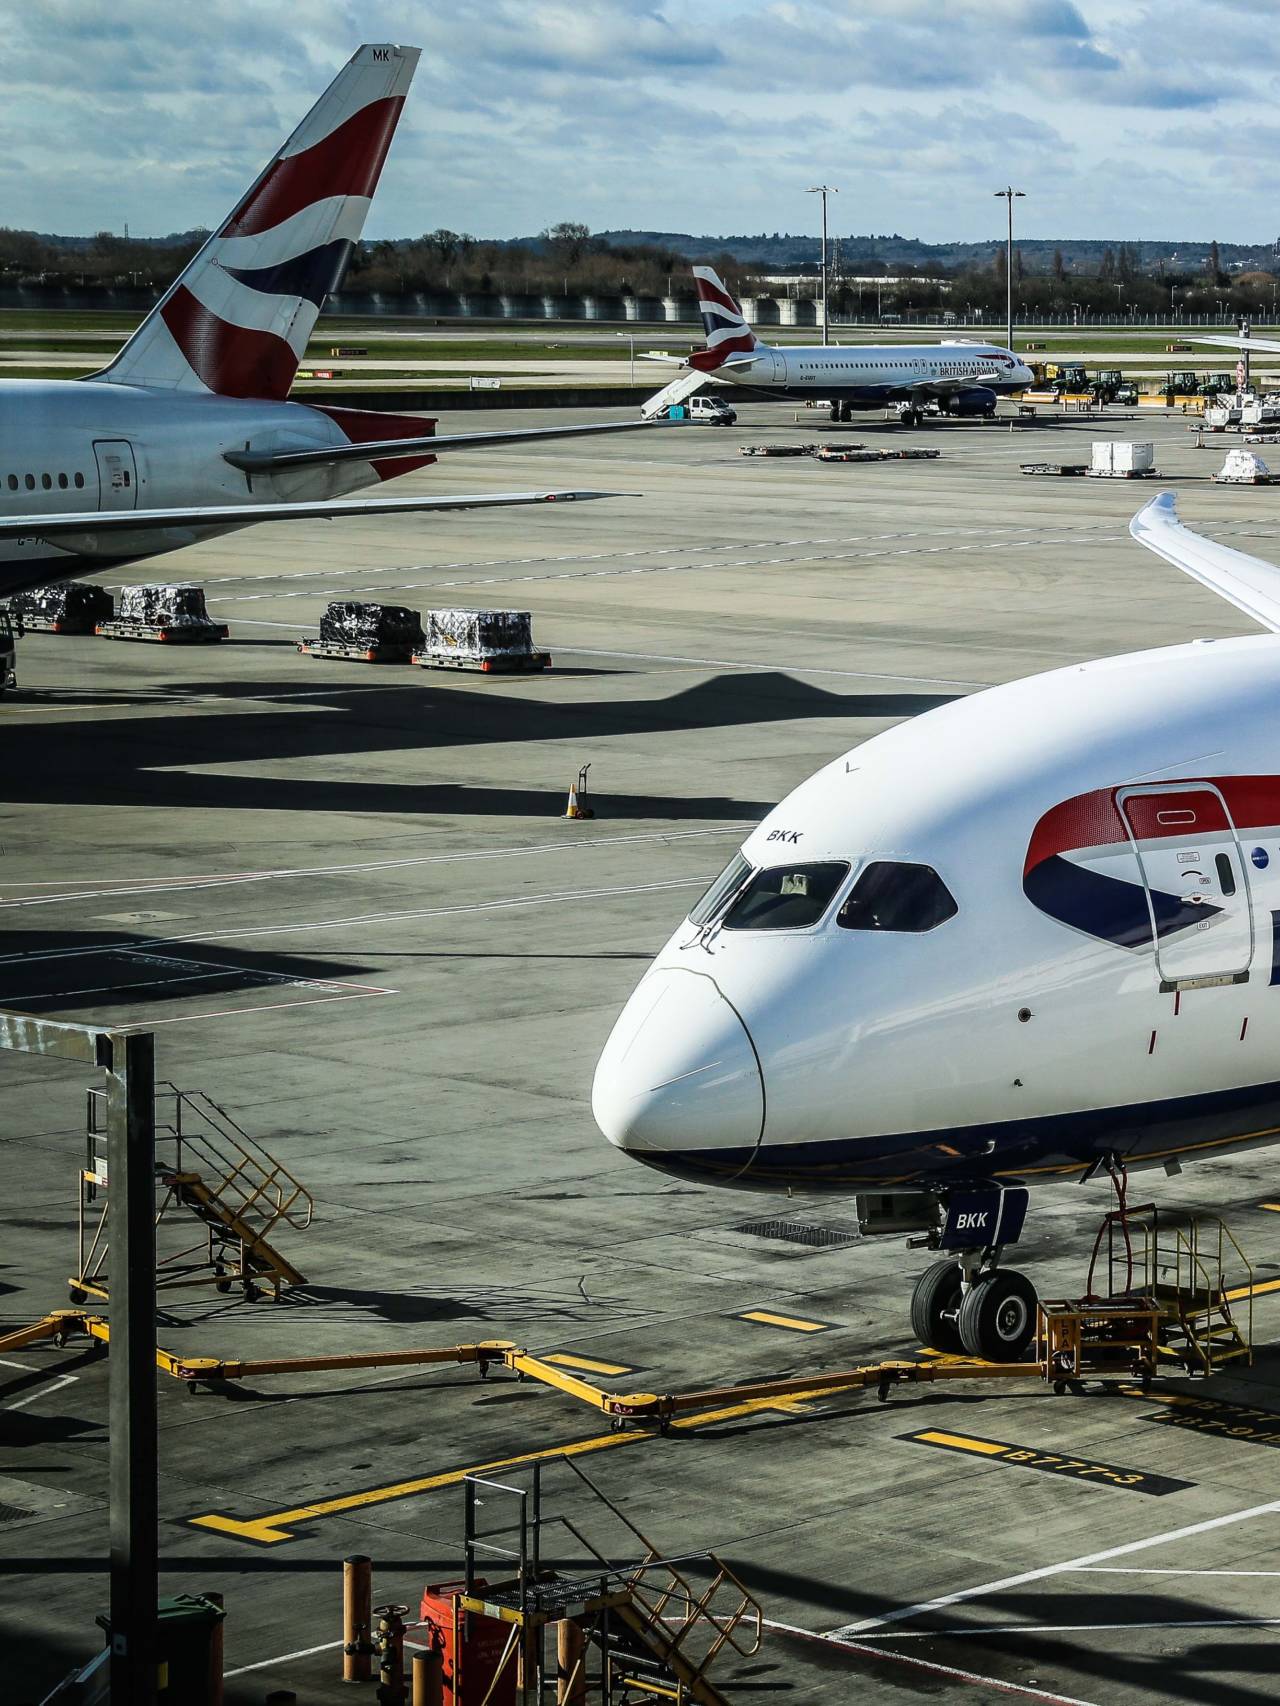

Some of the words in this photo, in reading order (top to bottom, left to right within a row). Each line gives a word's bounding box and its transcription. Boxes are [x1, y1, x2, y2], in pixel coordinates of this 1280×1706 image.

[373, 49, 390, 61] MK
[940, 367, 969, 376] BRITISH
[766, 830, 804, 844] BKK
[956, 1212, 989, 1229] BKK
[1002, 1451, 1144, 1484] B777-3
